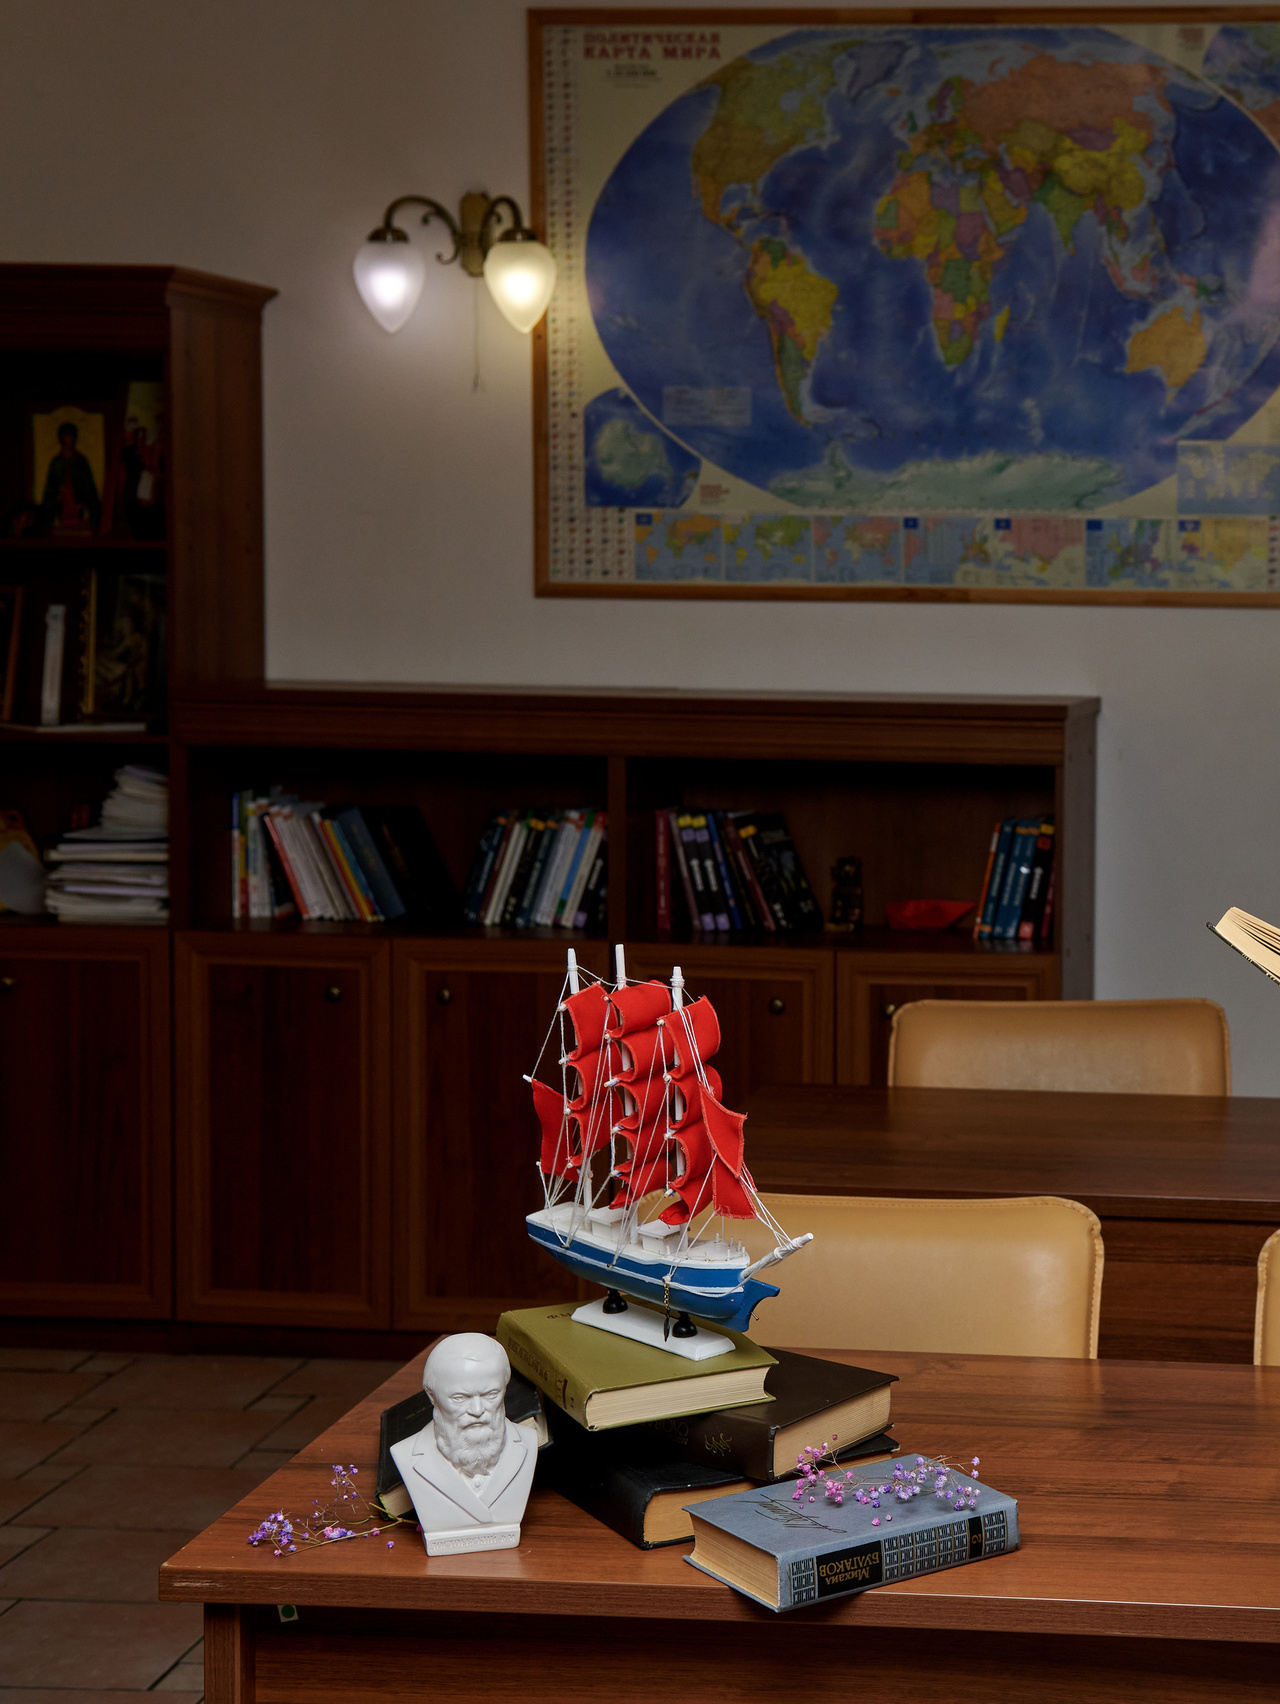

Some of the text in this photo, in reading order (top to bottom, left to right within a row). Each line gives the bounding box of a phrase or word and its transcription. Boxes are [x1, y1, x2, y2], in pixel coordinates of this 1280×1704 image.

[583, 32, 720, 44] ПОЛИТИЧЕСКАЯ
[583, 46, 721, 59] КАРТА МИРА
[971, 1533, 982, 1545] 2
[819, 1551, 880, 1577] БУЛГАКОВ
[825, 1567, 870, 1585] Михаил
